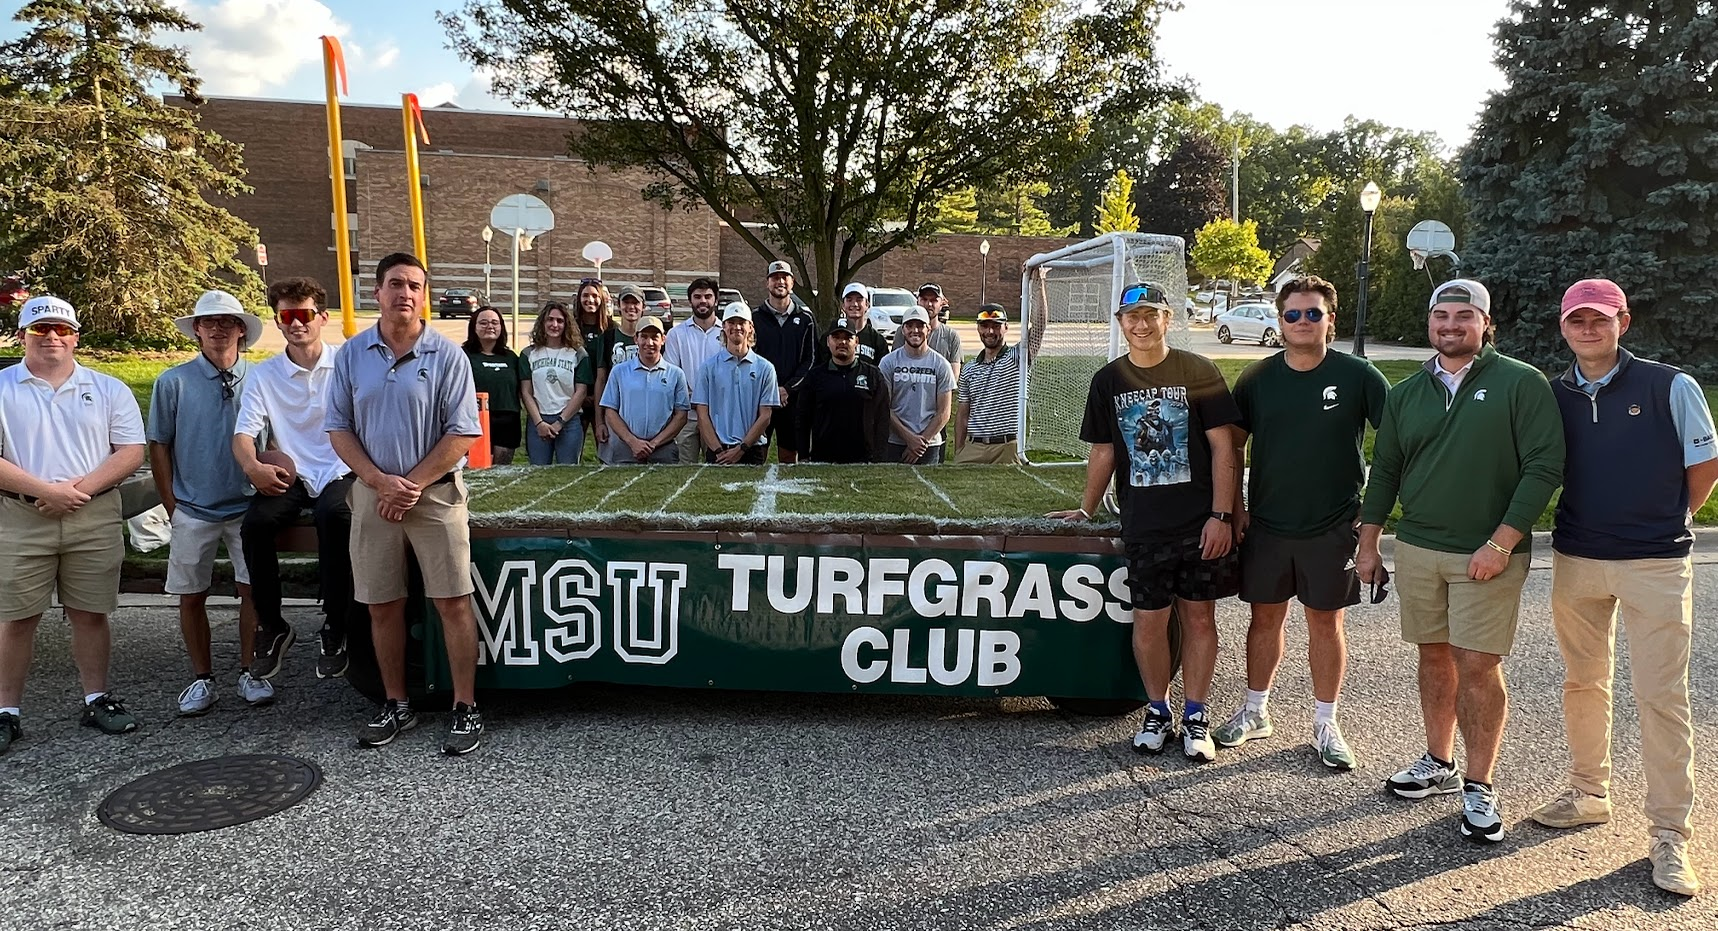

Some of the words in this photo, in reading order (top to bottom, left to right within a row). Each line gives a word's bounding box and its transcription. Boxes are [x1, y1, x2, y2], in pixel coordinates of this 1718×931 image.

[31, 305, 70, 317] SPARTY
[861, 344, 875, 360] STATE
[532, 357, 556, 370] MICHIGAN
[557, 358, 574, 373] STATE
[894, 366, 909, 374] GO
[909, 366, 936, 376] GREEN
[894, 373, 909, 382] GO
[910, 374, 936, 384] WHITE
[1113, 387, 1158, 414] KNEECAP
[1160, 386, 1191, 409] TOUR
[470, 558, 687, 666] MSU
[718, 554, 1134, 624] TURFGRASS
[841, 626, 1022, 687] CLUB
